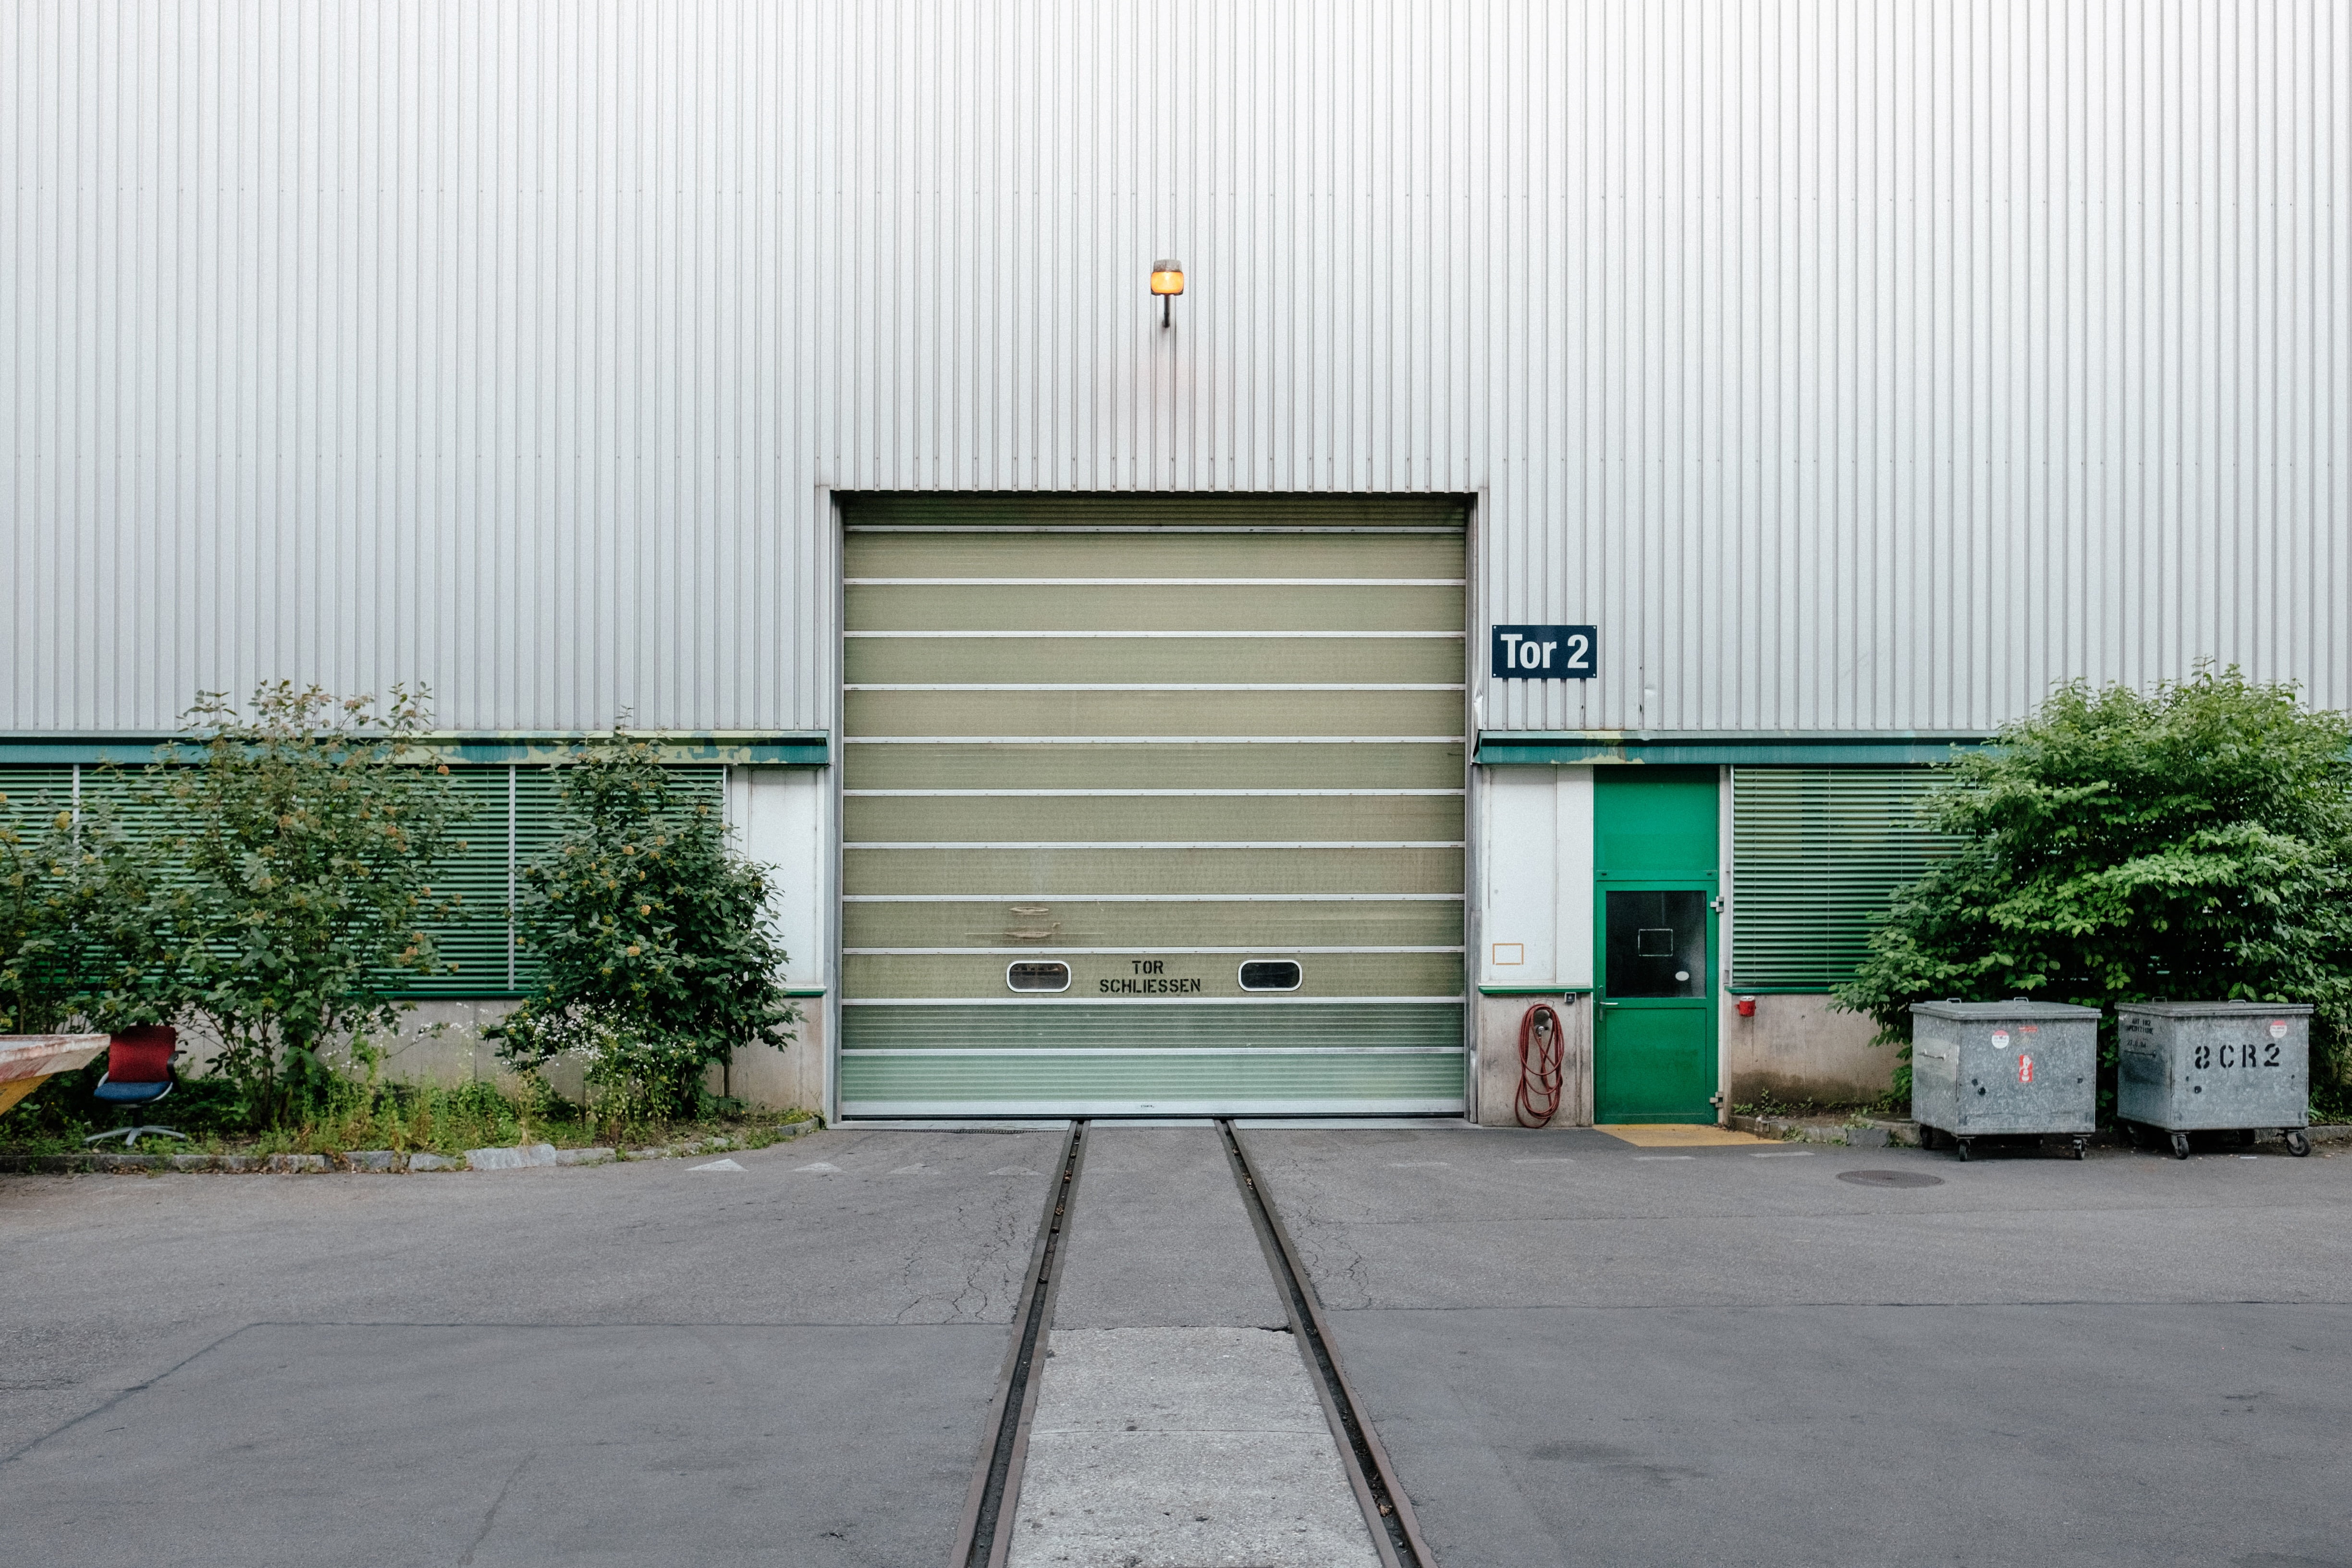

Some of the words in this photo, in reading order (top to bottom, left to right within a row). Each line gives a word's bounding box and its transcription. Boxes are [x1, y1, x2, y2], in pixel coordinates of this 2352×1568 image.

[1500, 634, 1557, 669] Tor
[1568, 634, 1589, 668] 2
[1132, 960, 1164, 974] TOR
[1100, 979, 1200, 993] SCHLIESSEN
